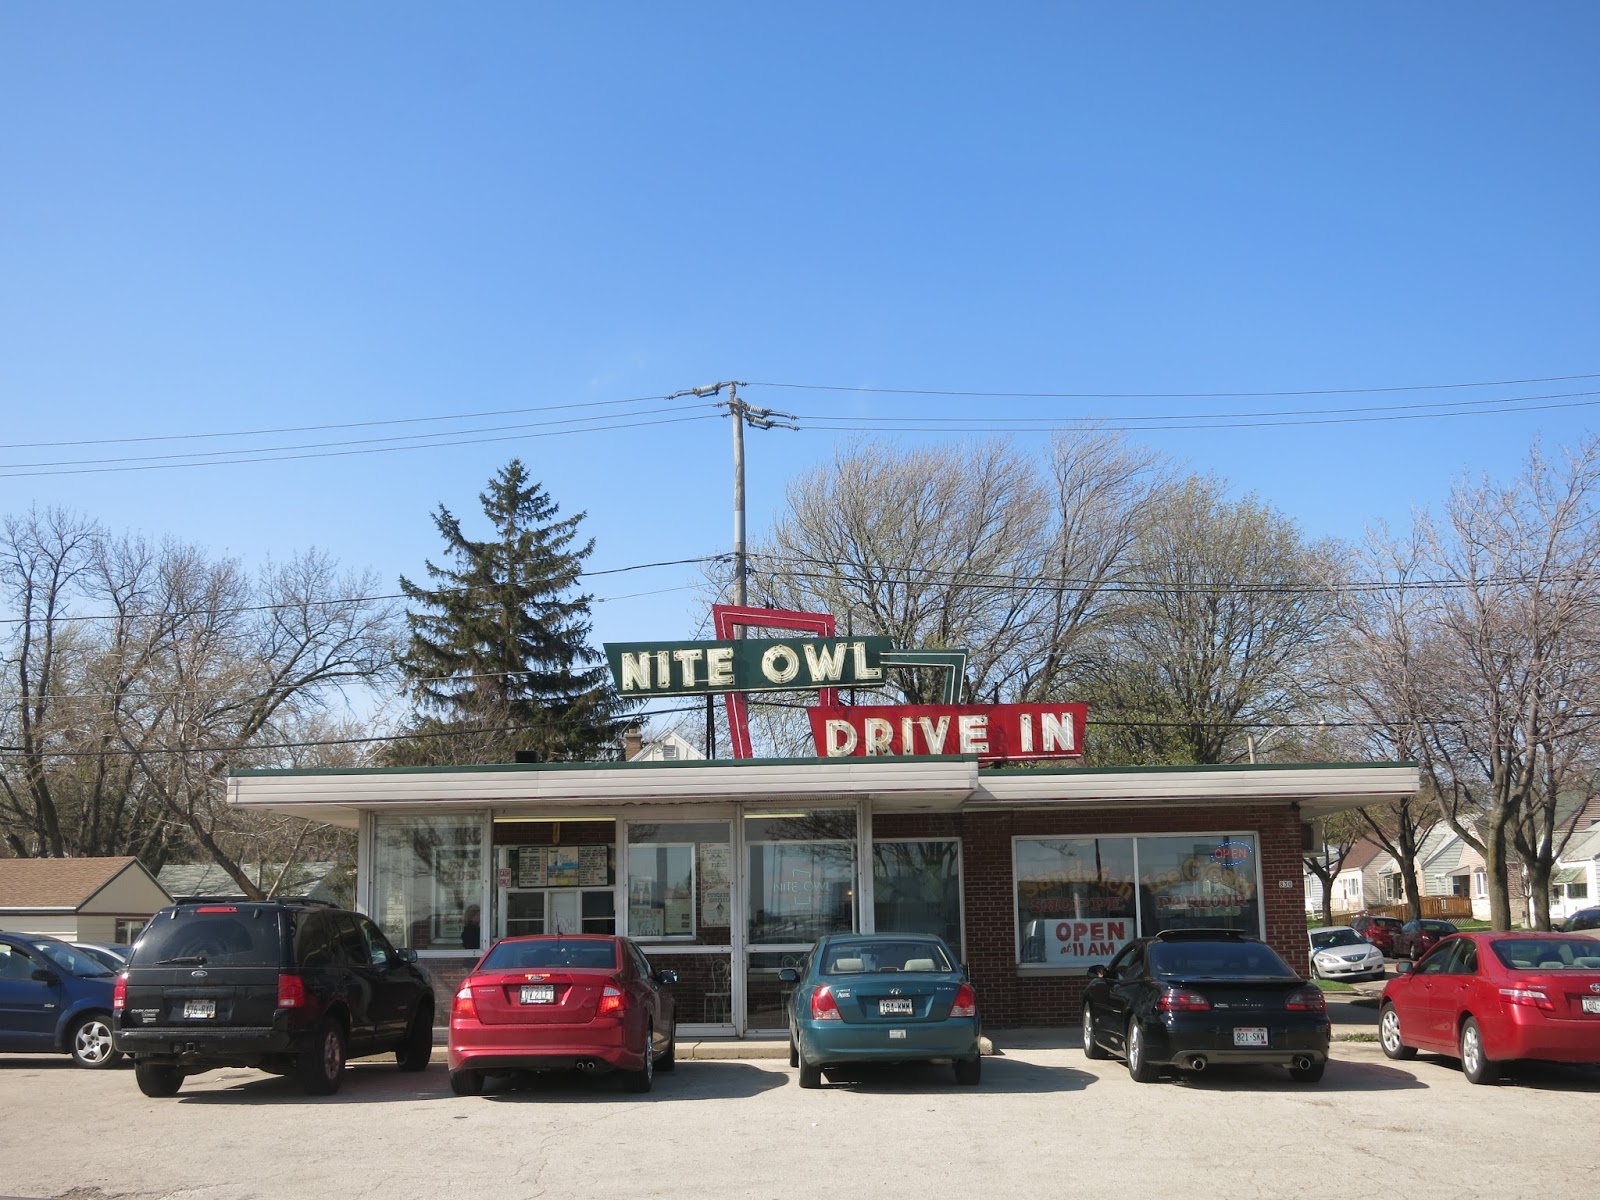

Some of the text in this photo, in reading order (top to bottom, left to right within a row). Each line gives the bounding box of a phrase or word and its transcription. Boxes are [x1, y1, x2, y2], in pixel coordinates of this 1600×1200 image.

[621, 641, 882, 691] NITE OWL
[825, 712, 1075, 757] DRIVE IN
[1214, 848, 1248, 859] OPEN
[773, 881, 831, 893] NITE OWL
[1019, 859, 1134, 900] Sandwich
[1143, 868, 1182, 895] Ice
[1030, 893, 1251, 913] SHOPPE PARLOUR
[1056, 922, 1125, 942] OPEN
[1060, 942, 1115, 957] at 11 AM
[1236, 1032, 1265, 1042] 821-SKW
